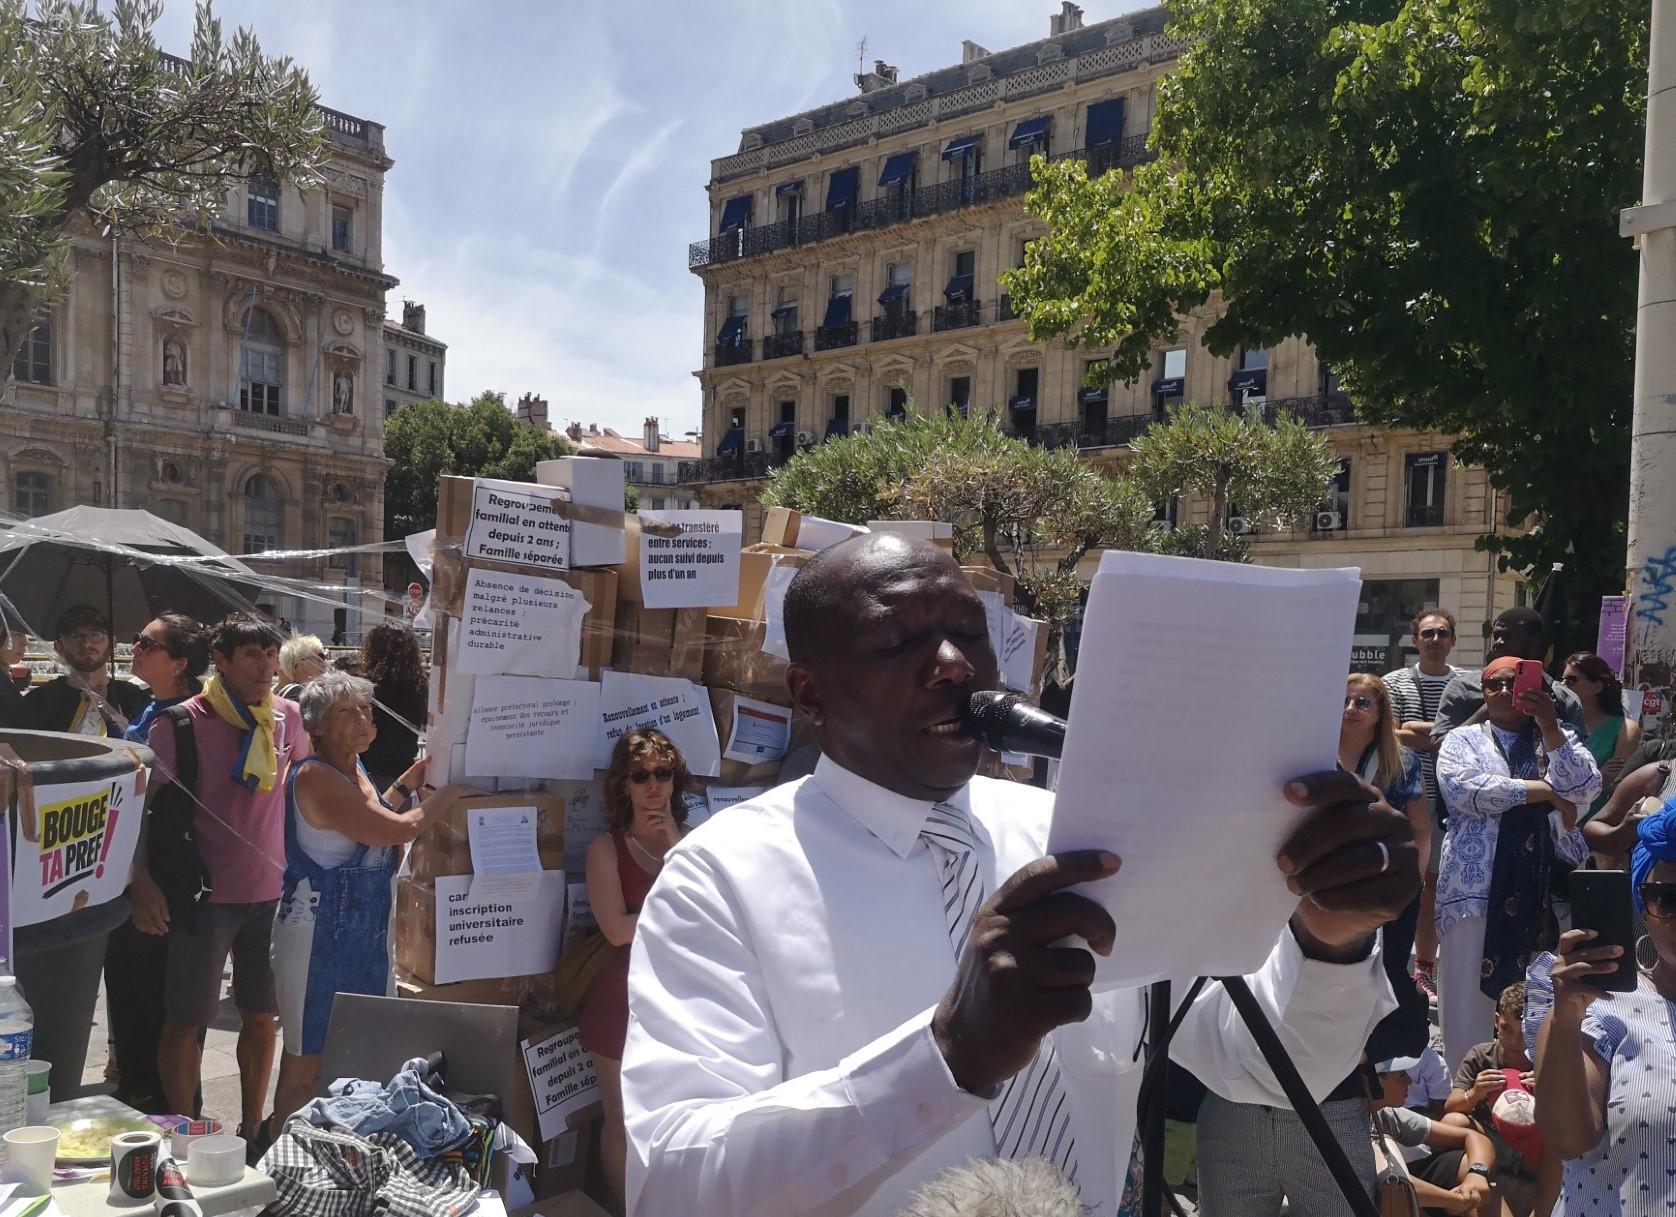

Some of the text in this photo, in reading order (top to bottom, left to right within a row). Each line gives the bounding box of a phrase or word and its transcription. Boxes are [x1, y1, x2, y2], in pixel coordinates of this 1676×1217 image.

[476, 509, 570, 533] familial en attent
[488, 529, 524, 544] depuis
[527, 536, 533, 544] 2
[536, 538, 554, 547] ans
[648, 538, 670, 548] entre
[672, 538, 708, 548] services
[480, 544, 563, 565] Famille séparée
[648, 552, 724, 564] aucun suivi depuis
[648, 569, 696, 581] plus d'un an
[475, 579, 574, 599] Absence de décision
[473, 592, 558, 608] malgré plusieurs
[472, 605, 516, 615] relances
[470, 617, 520, 628] précarité
[469, 628, 542, 641] administrative
[468, 640, 504, 650] durable
[1352, 650, 1385, 659] ubble
[43, 794, 108, 850] BOUGE
[40, 848, 63, 886] TA
[449, 904, 512, 916] inscription
[449, 917, 524, 931] universitaire
[449, 933, 493, 946] refusée
[532, 1049, 580, 1078] familial en
[548, 1066, 576, 1087] depuis
[577, 1062, 584, 1072] 2
[545, 1082, 579, 1105] Famille
